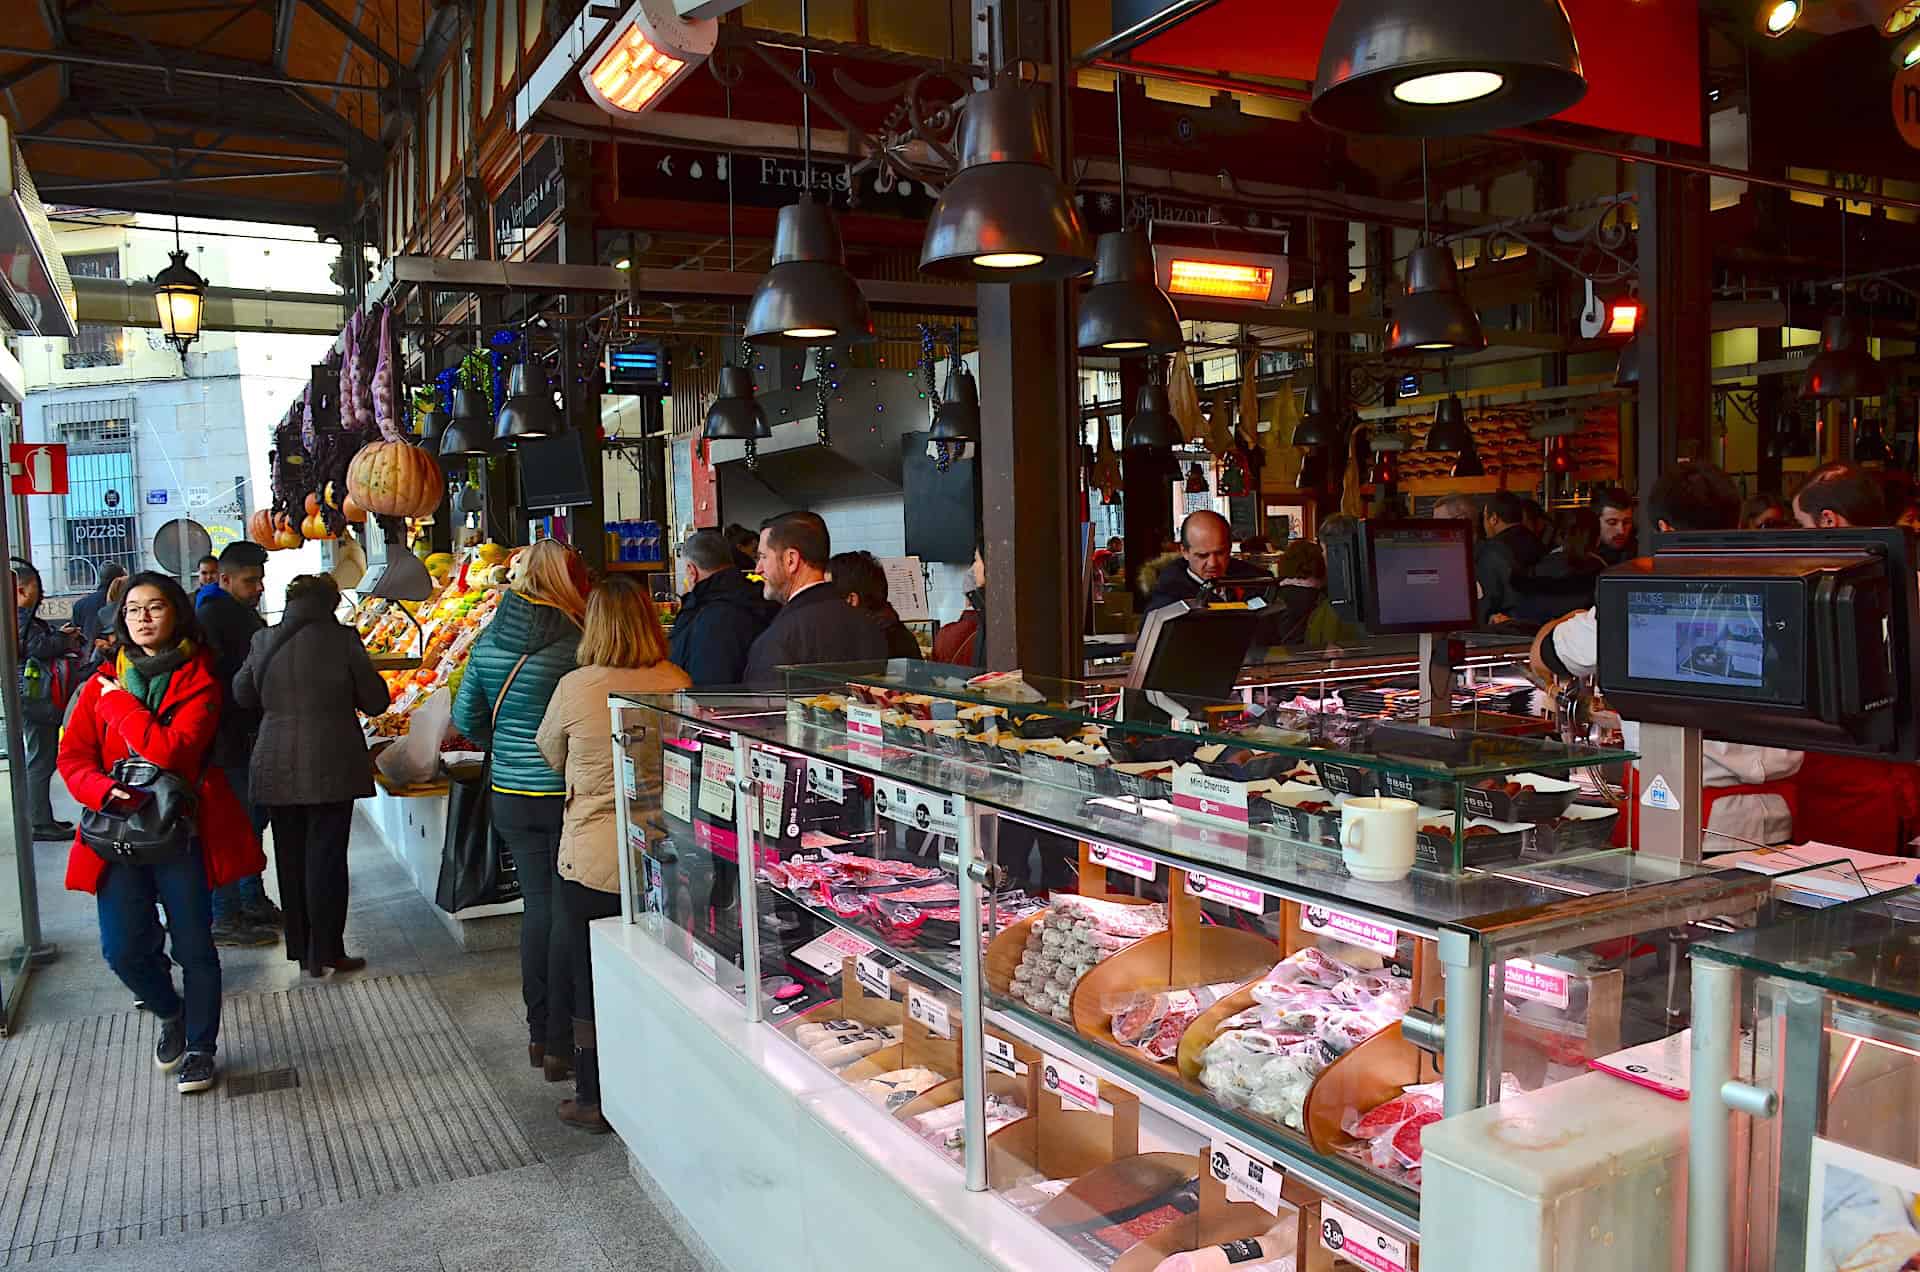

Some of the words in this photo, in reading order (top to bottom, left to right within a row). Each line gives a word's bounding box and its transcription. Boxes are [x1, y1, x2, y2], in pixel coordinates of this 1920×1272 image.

[760, 157, 850, 191] Frutas
[510, 190, 539, 227] Veruras
[74, 523, 126, 542] pizzas
[1189, 776, 1203, 788] Mini
[1204, 779, 1231, 794] Chorizos
[1323, 1222, 1343, 1246] 3,90
